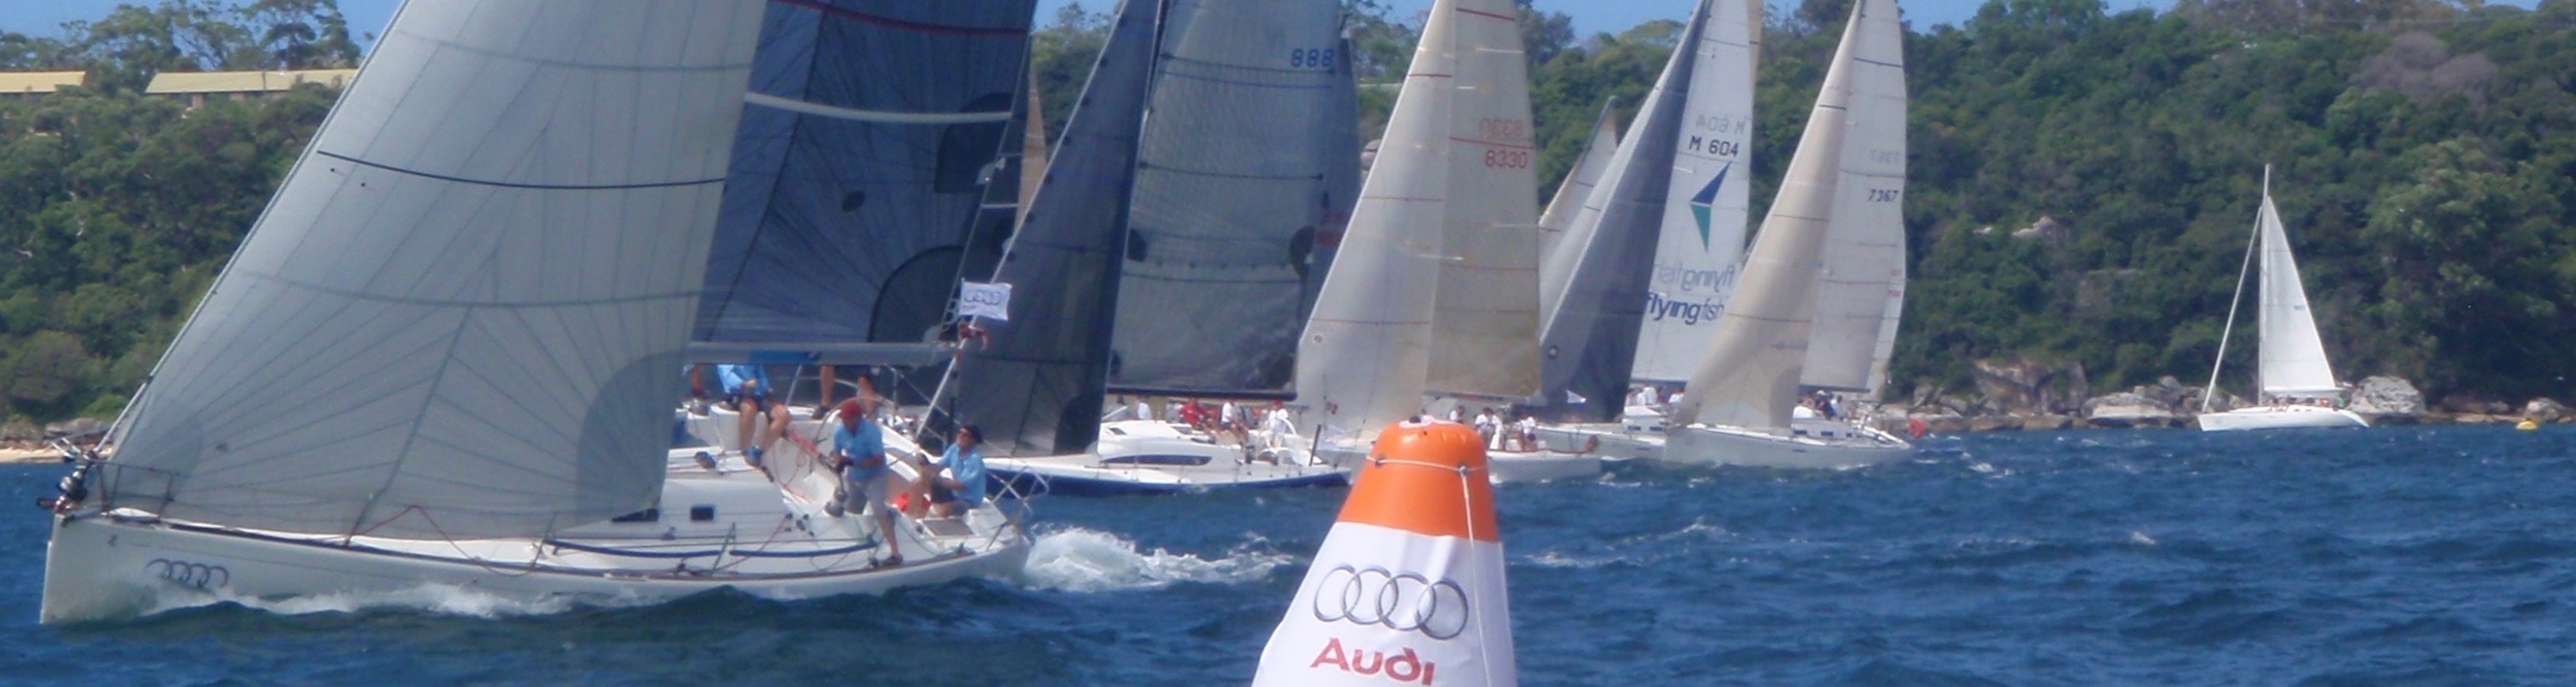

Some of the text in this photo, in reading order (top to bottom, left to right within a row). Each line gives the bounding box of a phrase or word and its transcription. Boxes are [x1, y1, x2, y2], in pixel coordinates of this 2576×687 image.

[1291, 48, 1334, 68] 888
[1689, 135, 1739, 157] M 604
[1485, 149, 1527, 168] 8330
[1309, 637, 1435, 685] Audi
